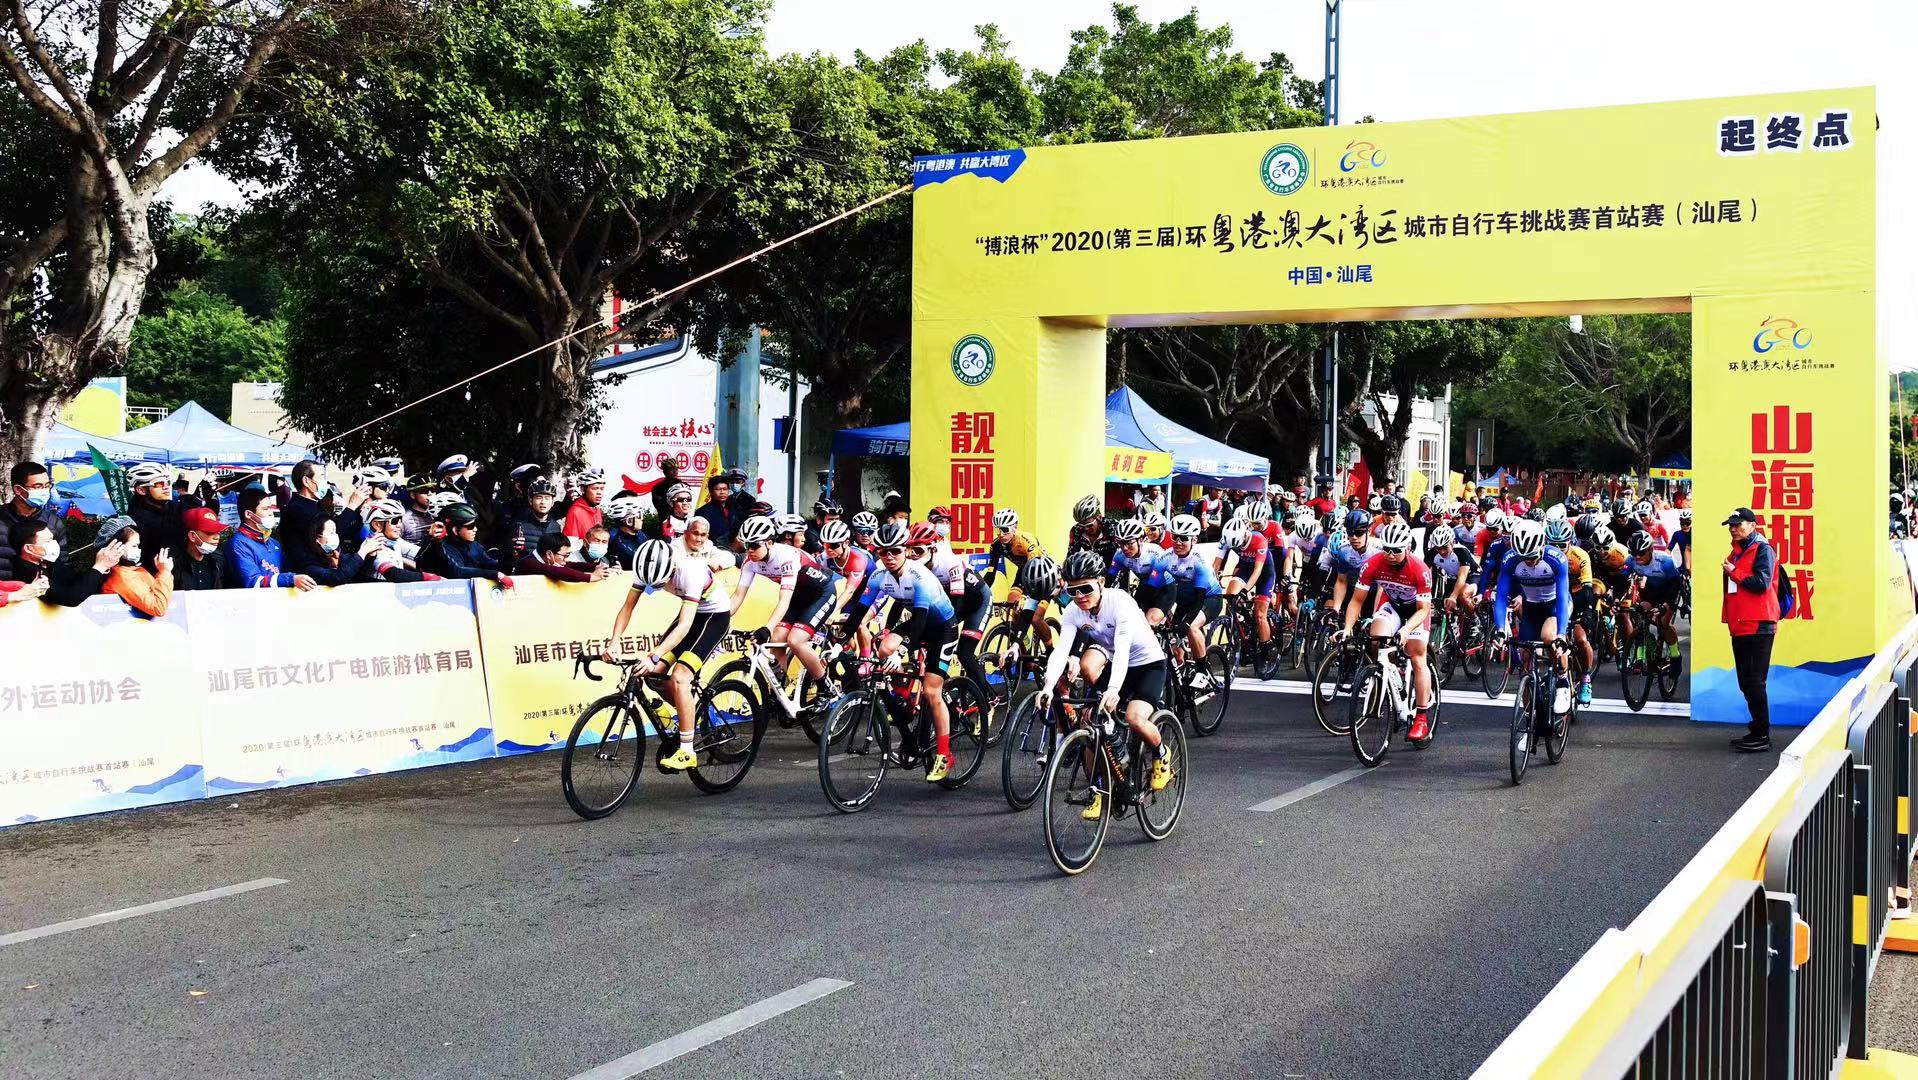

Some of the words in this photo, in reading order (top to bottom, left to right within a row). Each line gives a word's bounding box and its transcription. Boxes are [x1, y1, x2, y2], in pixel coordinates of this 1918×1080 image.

[1720, 112, 1850, 154] 起终点
[642, 417, 716, 440] 社会主义核心
[868, 439, 910, 456] 骑行粤
[950, 411, 995, 555] 靓丽明
[1751, 405, 1814, 621] 山海湖城
[207, 649, 474, 694] 汕尾市文化广电旅游体育局
